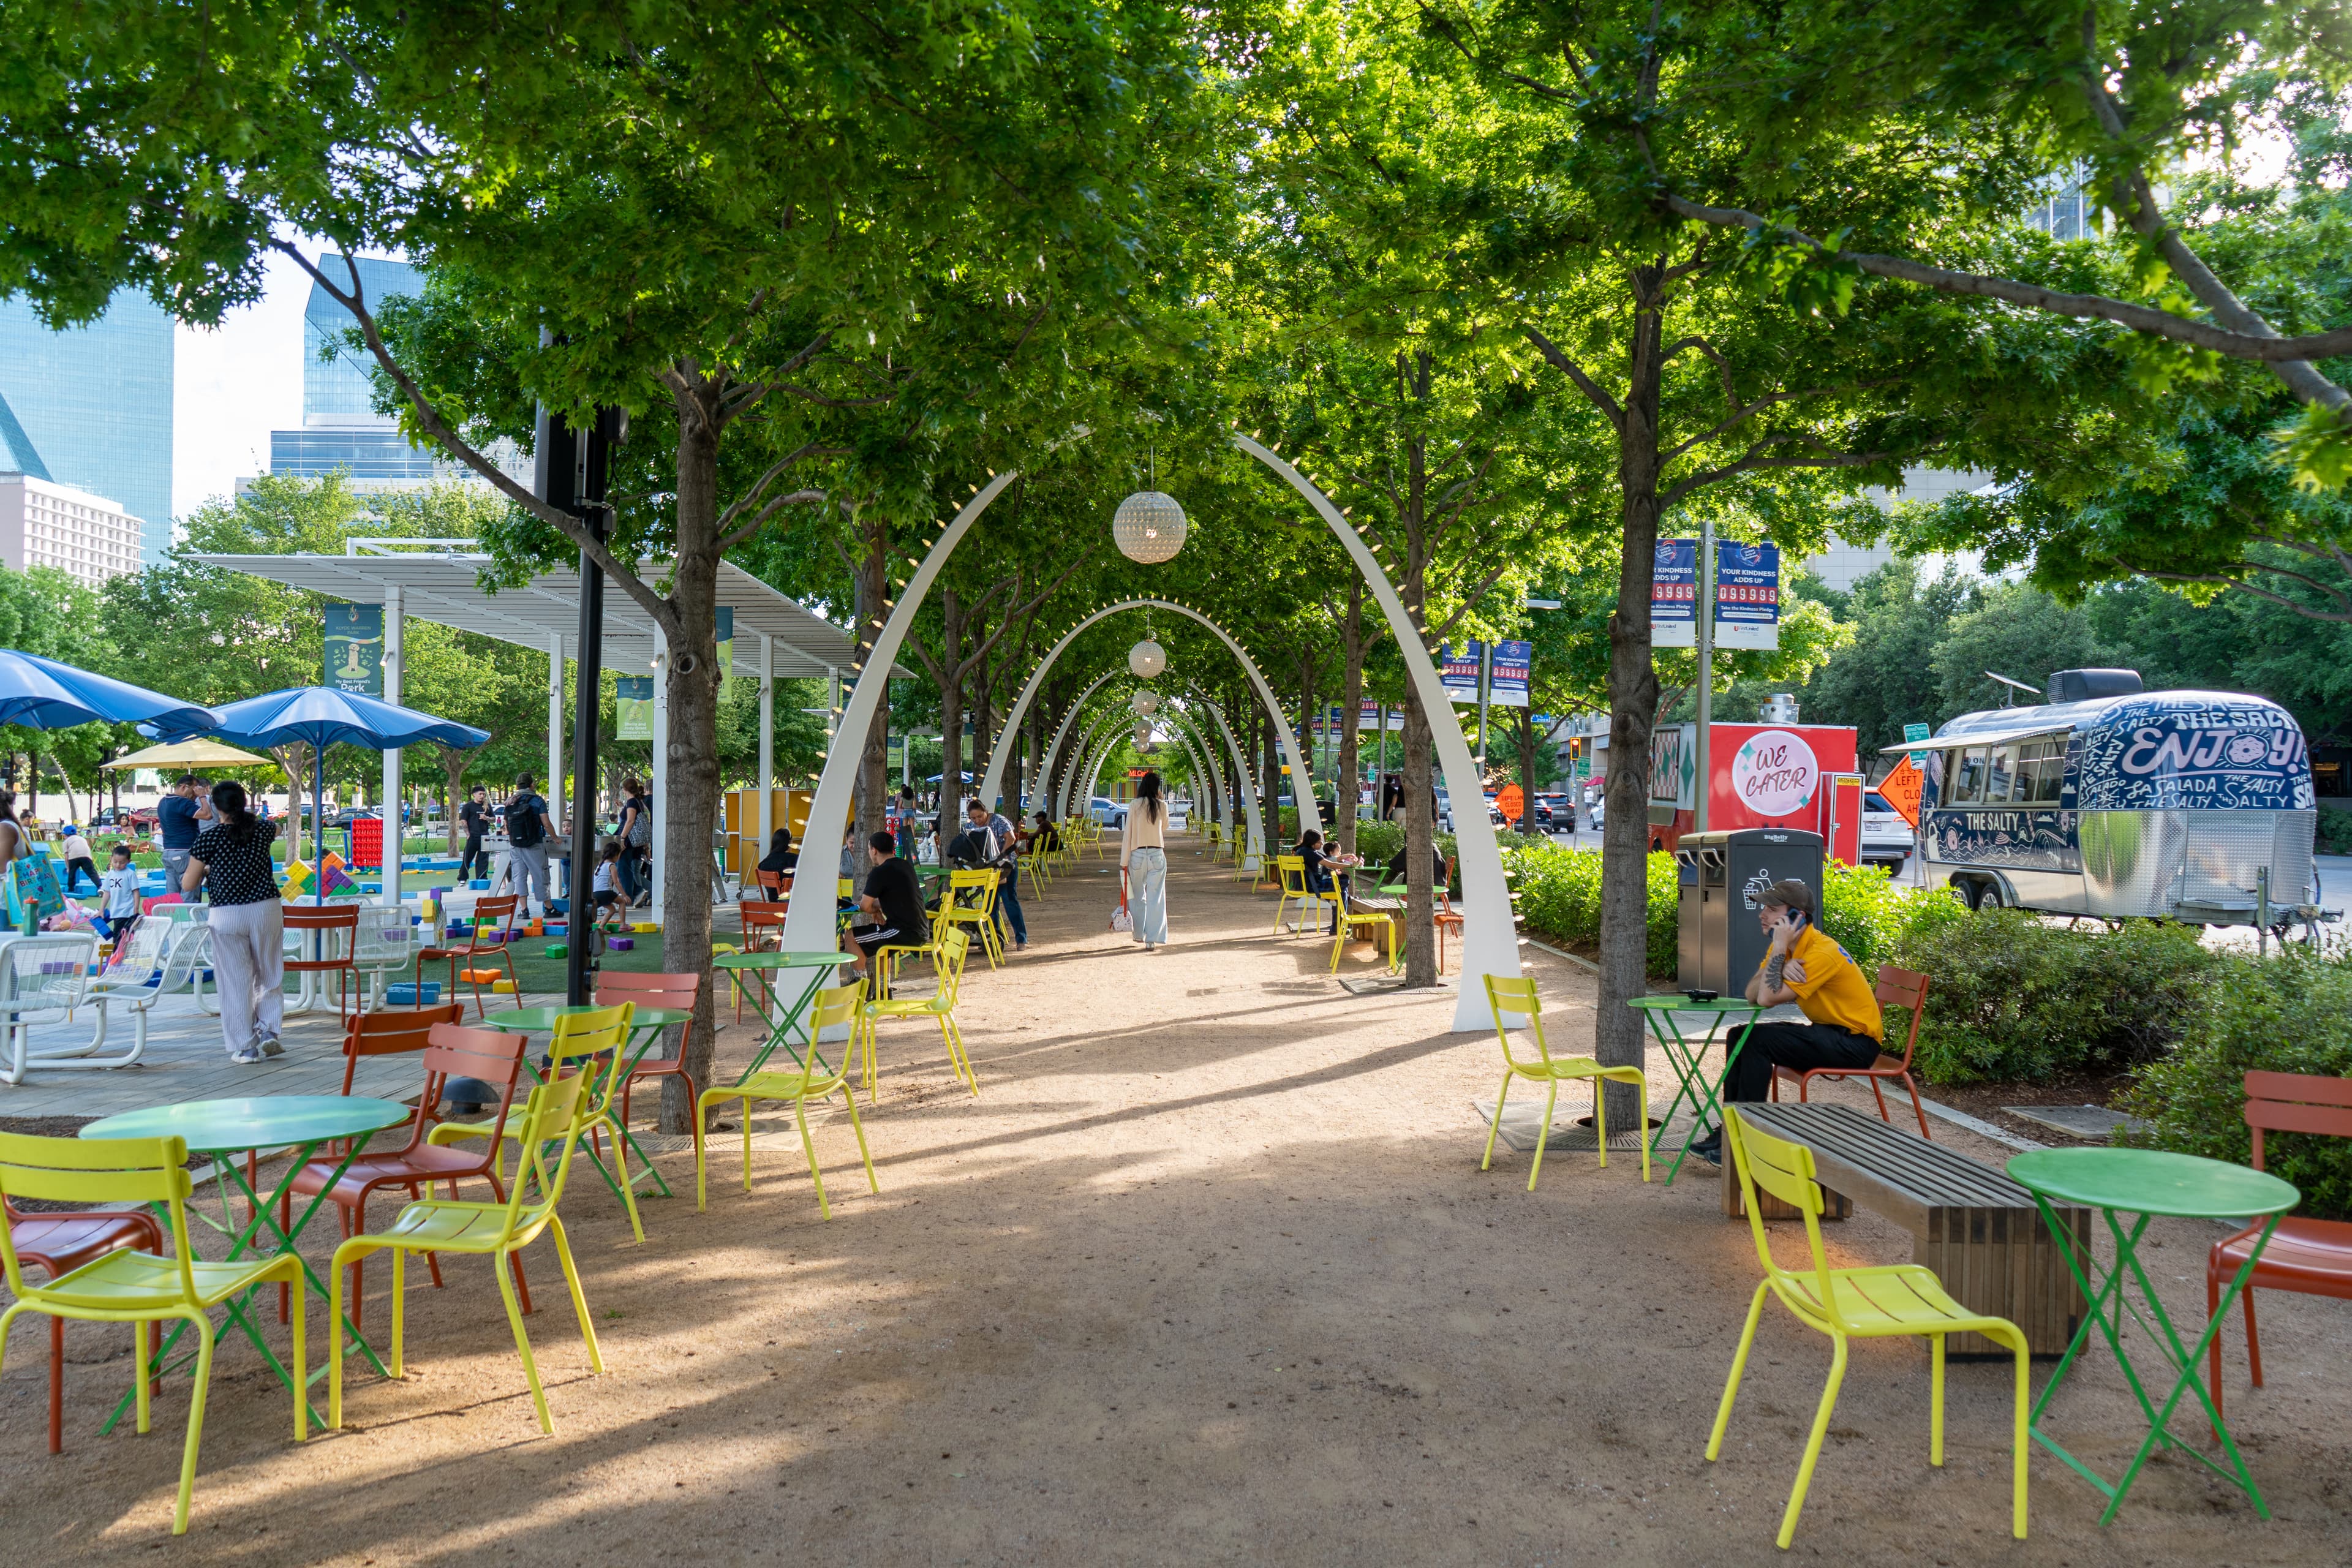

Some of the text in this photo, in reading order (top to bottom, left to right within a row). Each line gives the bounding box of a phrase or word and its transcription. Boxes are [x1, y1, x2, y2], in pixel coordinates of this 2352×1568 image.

[1656, 586, 1693, 598] 9999
[2125, 708, 2150, 719] THE
[2171, 712, 2229, 729] THE
[2114, 716, 2168, 736] SALTY
[2086, 730, 2113, 747] ALTY
[1756, 744, 1787, 771] WE
[1745, 766, 1807, 797] CATER
[1896, 775, 1917, 786] LEFT
[2145, 777, 2217, 797] SALADA
[2239, 778, 2285, 793] SALTY
[1904, 790, 1920, 800] CLO
[2132, 799, 2166, 809] THE
[2165, 793, 2212, 809] SALTY
[2215, 782, 2288, 810] THE SALTY
[1966, 812, 2020, 831] THE SALTY
[110, 878, 123, 888] CK
